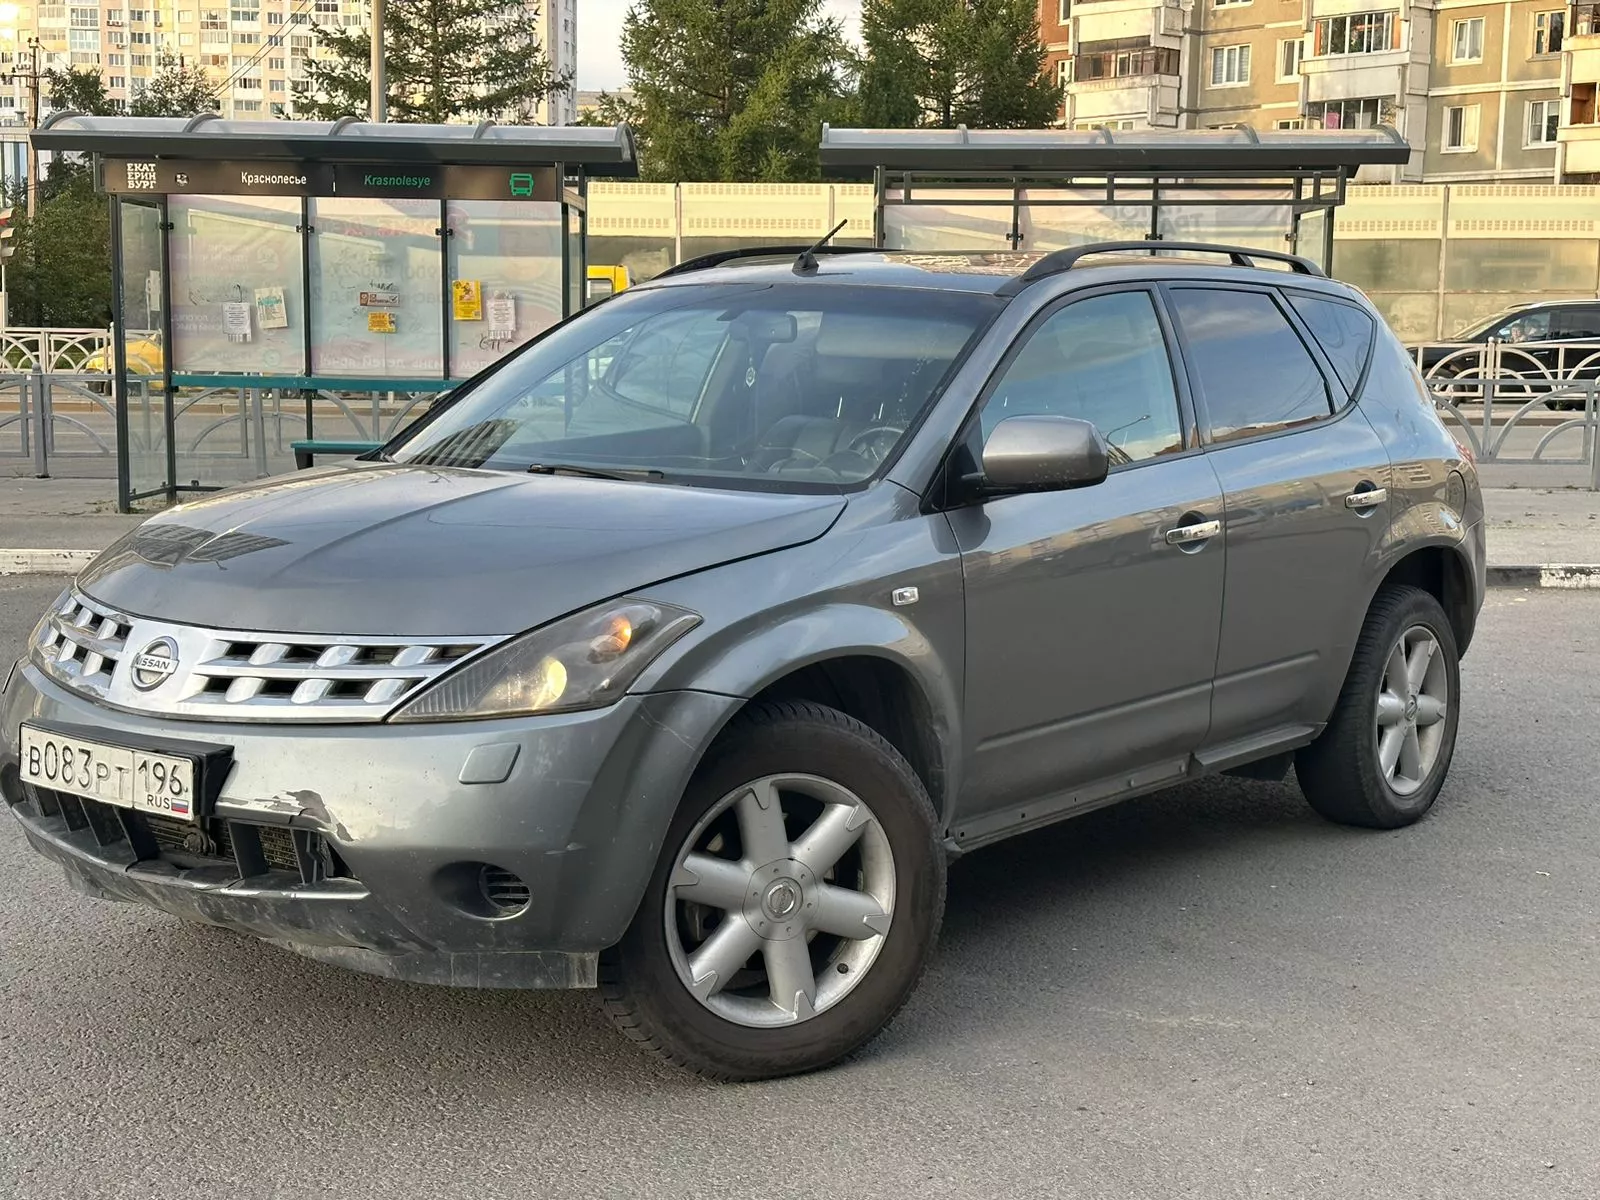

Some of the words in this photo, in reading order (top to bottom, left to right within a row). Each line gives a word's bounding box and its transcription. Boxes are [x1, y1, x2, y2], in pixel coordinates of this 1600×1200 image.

[127, 163, 156, 172] ЕКАТ
[127, 172, 157, 180] ЕРИН
[241, 171, 307, 186] Краснолесье
[364, 174, 431, 188] Krasnolesye
[127, 180, 157, 189] БУРГ
[138, 759, 183, 796] 196
[146, 794, 171, 810] RUS
